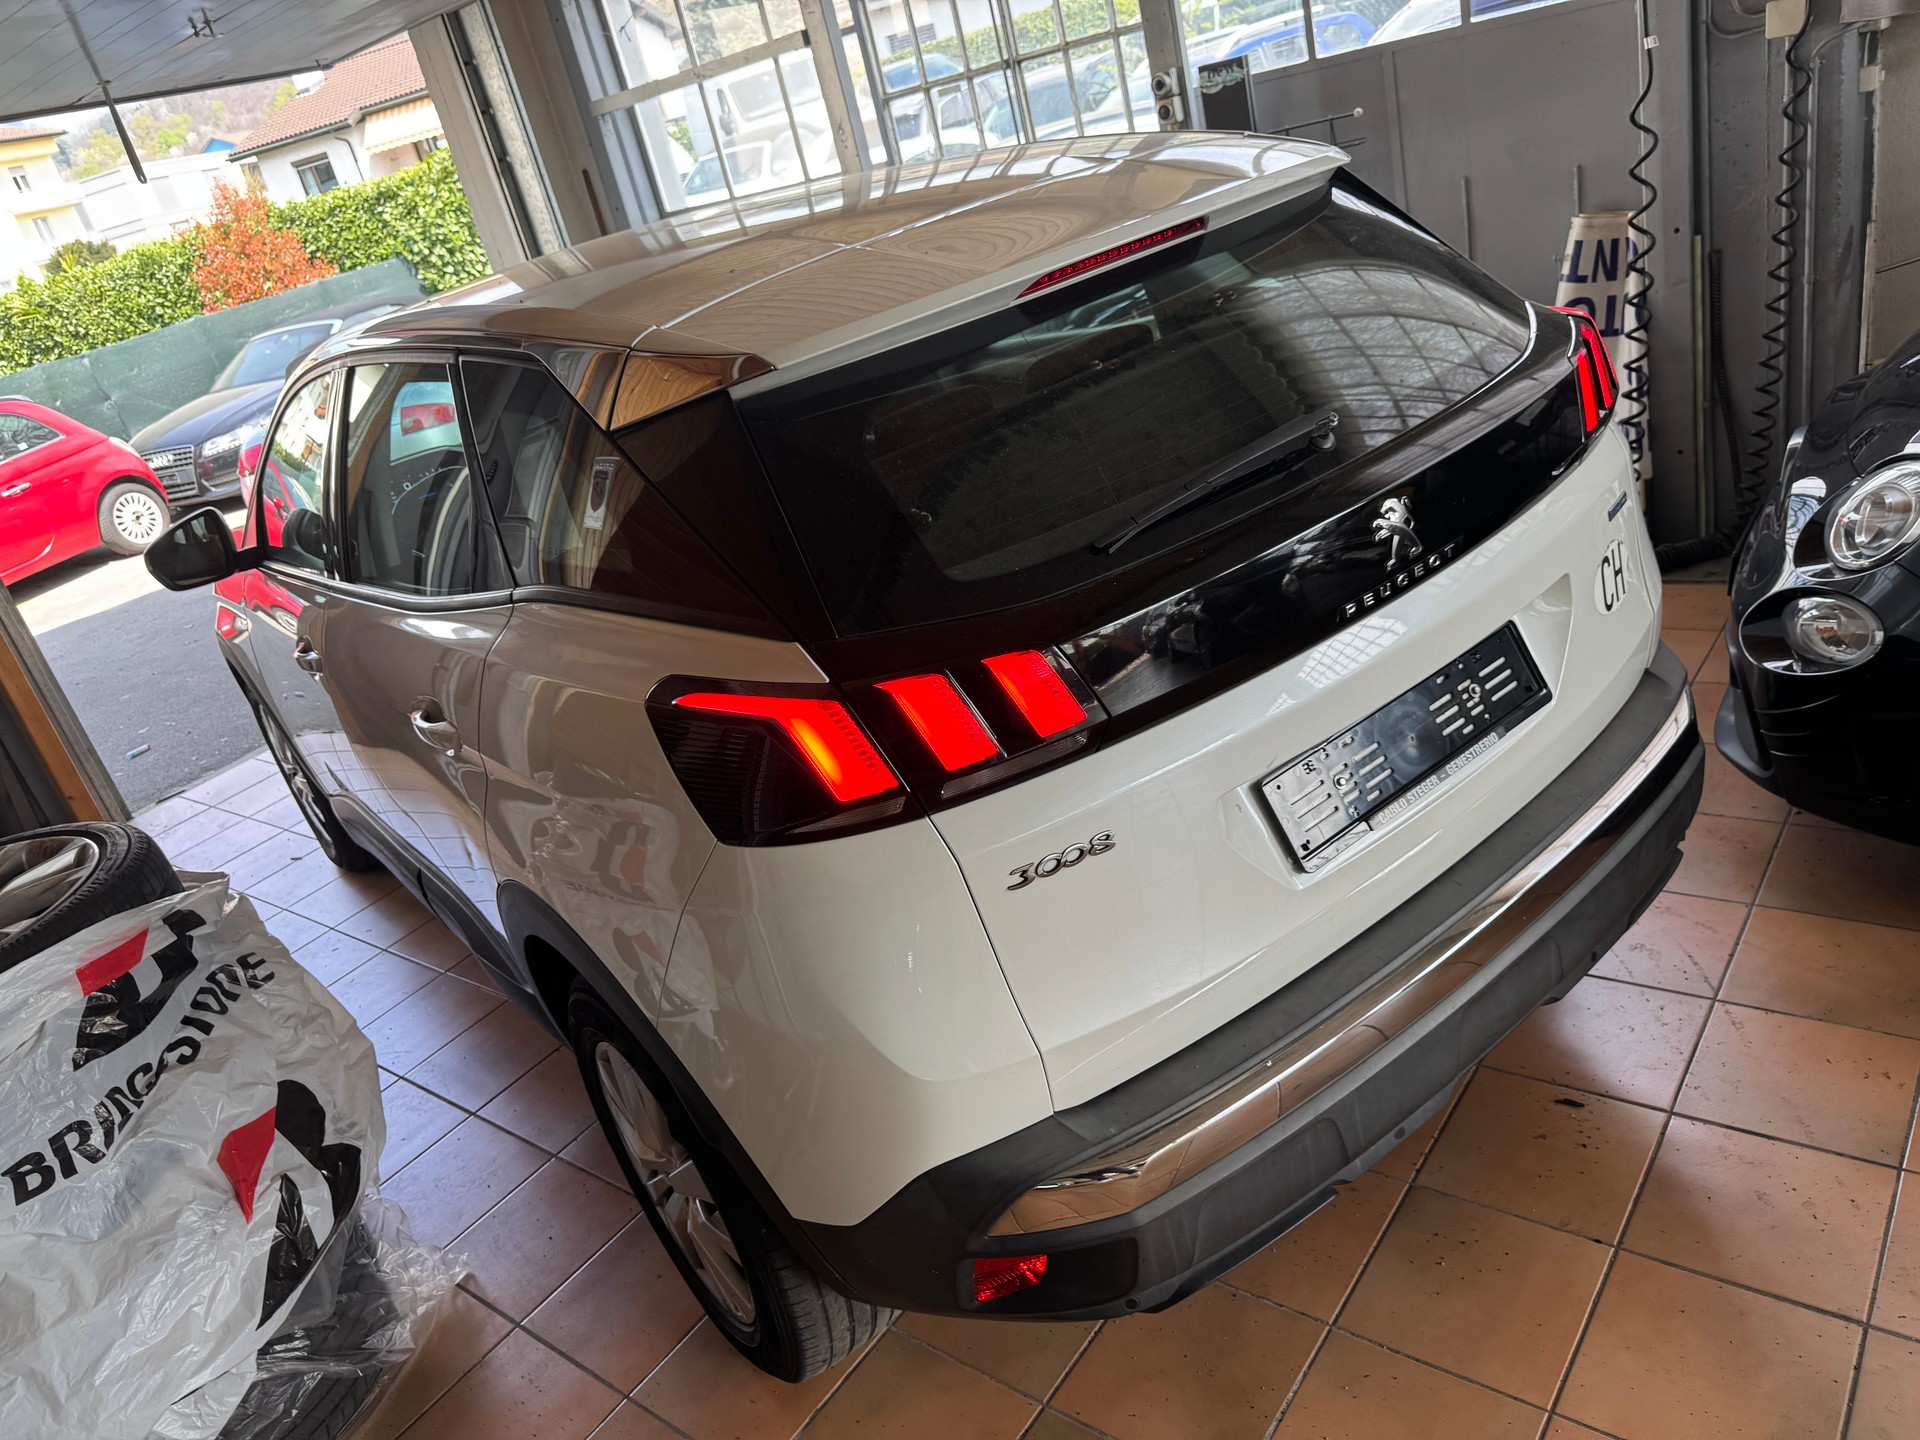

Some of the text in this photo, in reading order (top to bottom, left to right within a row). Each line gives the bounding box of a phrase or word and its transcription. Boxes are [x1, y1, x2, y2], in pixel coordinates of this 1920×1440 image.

[1345, 543, 1455, 618] PEUGEOT
[1601, 541, 1626, 612] CH
[1379, 797, 1408, 824] CARLO
[1406, 775, 1440, 803] STEGER
[1445, 732, 1499, 775] GENESTRERIO
[1007, 829, 1116, 891] 3008
